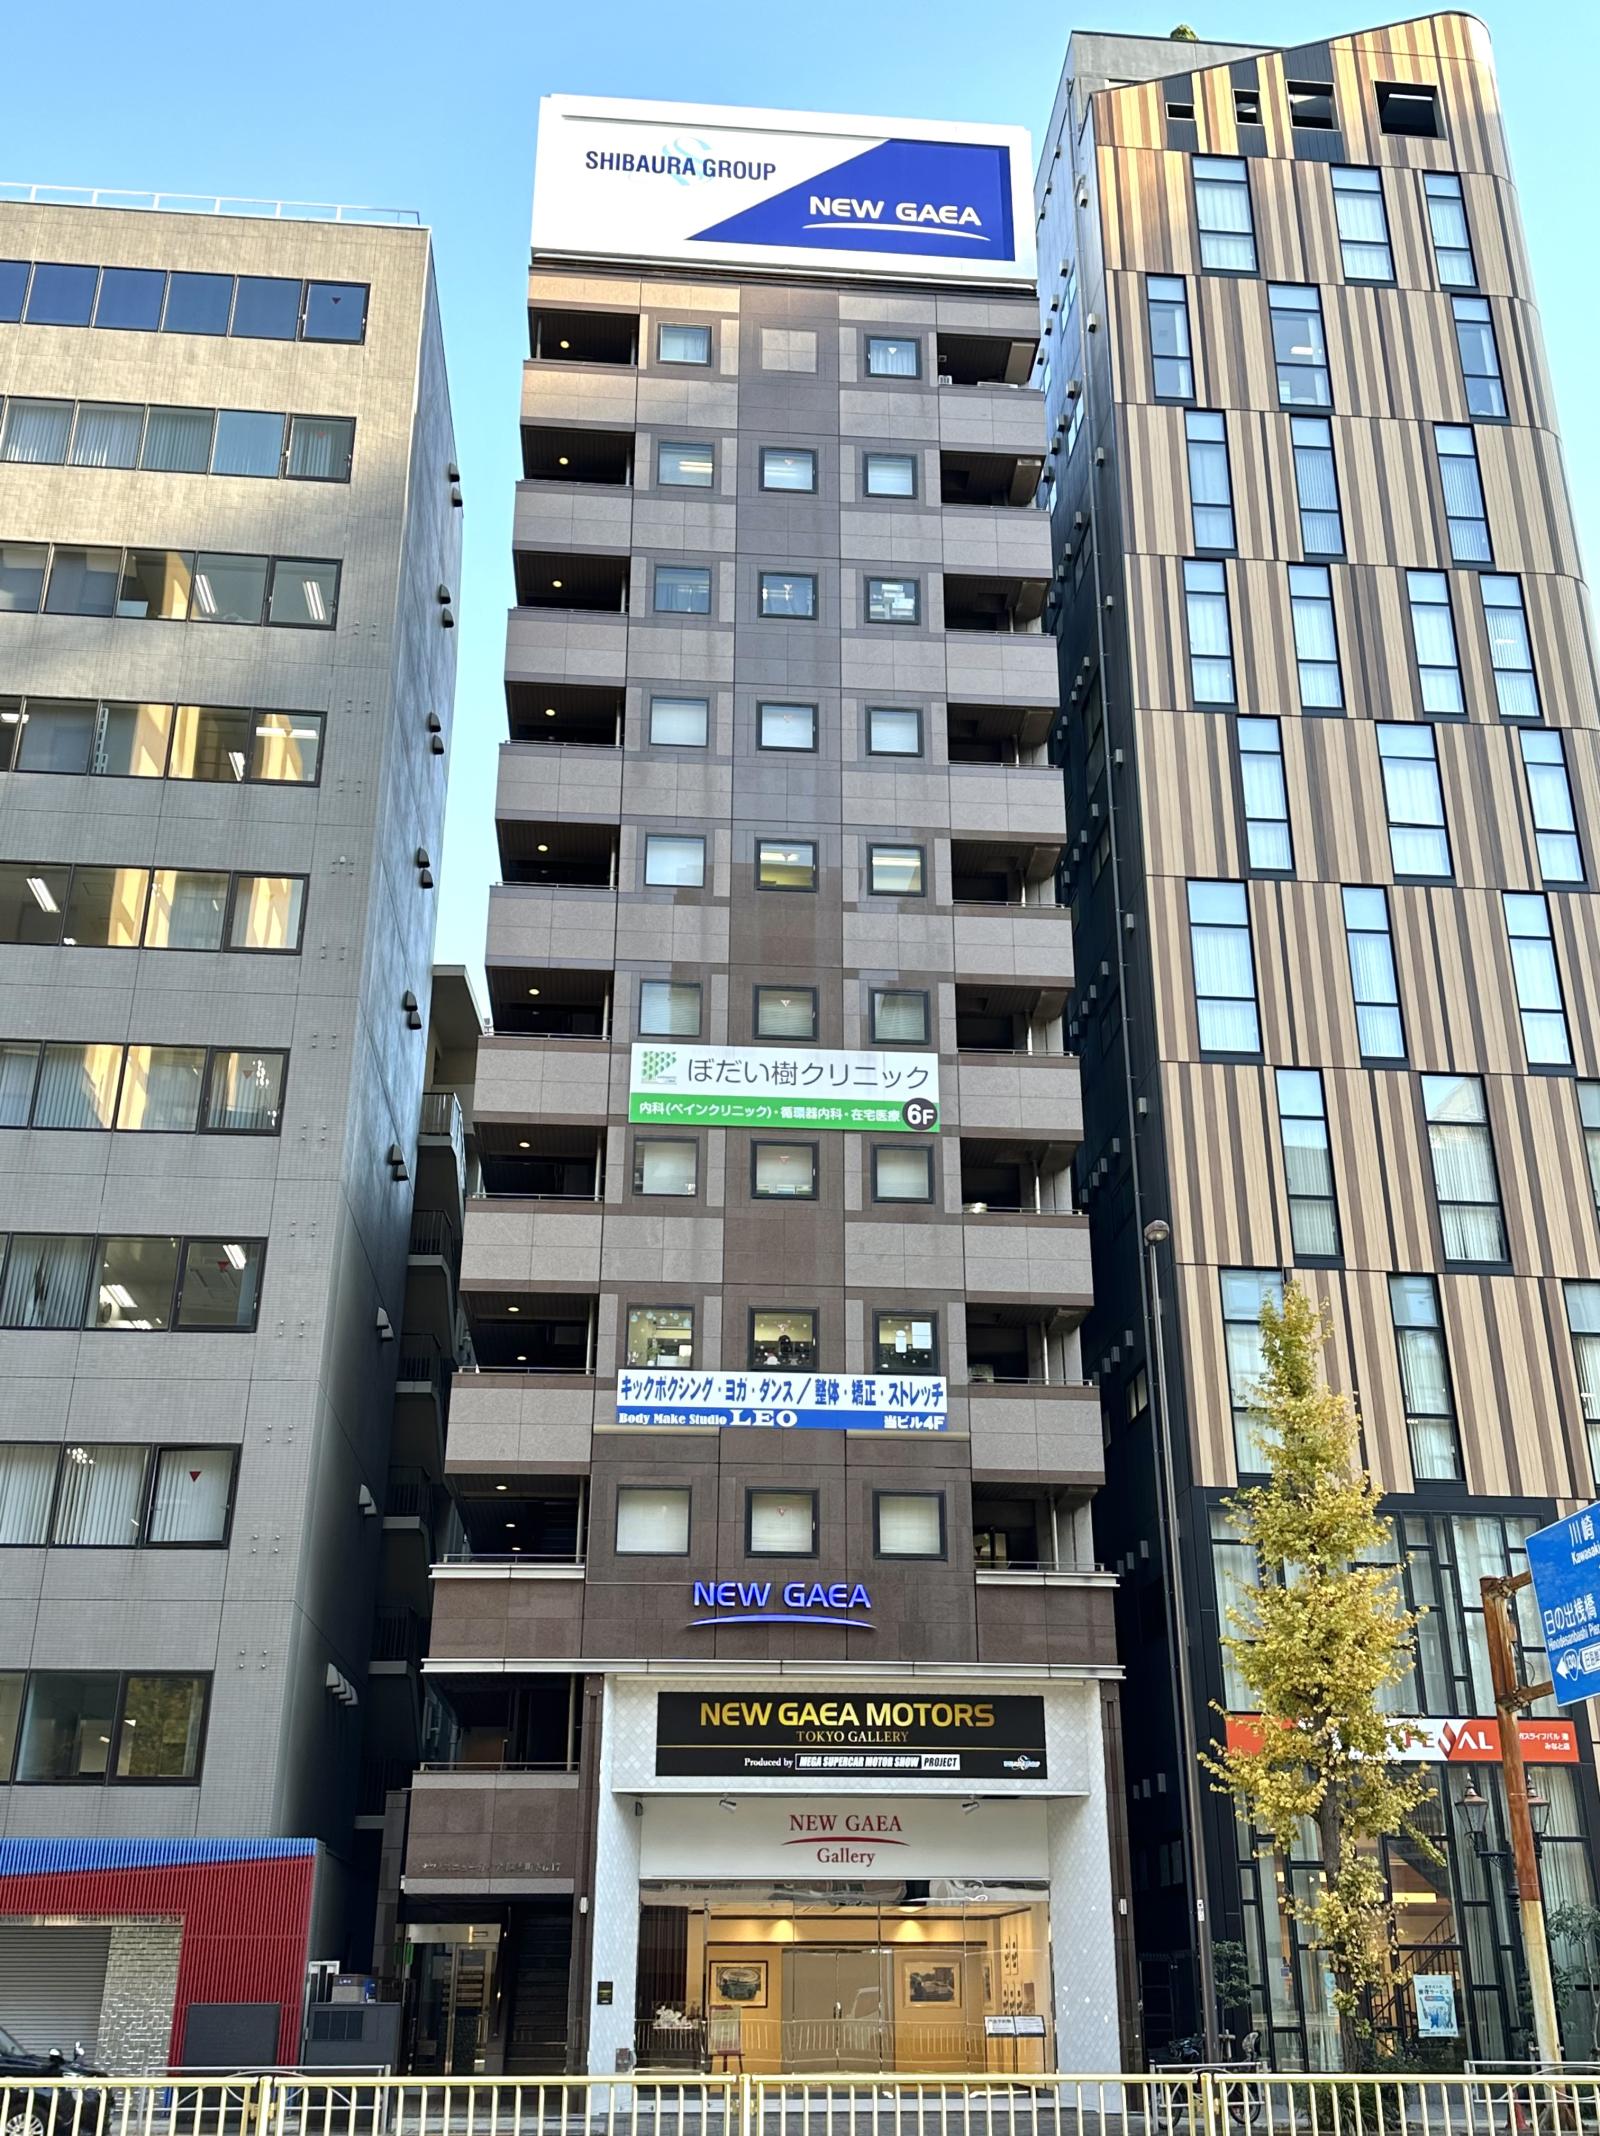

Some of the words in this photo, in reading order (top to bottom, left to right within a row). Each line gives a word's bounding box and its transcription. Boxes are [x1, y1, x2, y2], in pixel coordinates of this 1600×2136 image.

[585, 150, 696, 176] SHIBAURA
[702, 158, 776, 181] GROUP
[809, 195, 885, 219] NEW
[895, 202, 982, 226] GAEA
[687, 1058, 929, 1090] ぼだい樹クリニック
[906, 1103, 935, 1126] 6F
[618, 1412, 651, 1425] Body
[653, 1412, 687, 1425] Make
[689, 1413, 728, 1426] Studio
[729, 1409, 798, 1428] LEO
[883, 1414, 945, 1431] 当ビル4F
[1568, 1514, 1595, 1549] 川崎
[1570, 1540, 1600, 1566] Kawasaki
[692, 1580, 771, 1608] NEW
[782, 1581, 872, 1609] GAEA
[1543, 1592, 1598, 1636] 日の出桟橋
[700, 1702, 773, 1727] NEW
[777, 1702, 860, 1727] GAEA
[865, 1702, 996, 1728] MOTORS
[795, 1729, 845, 1743] TOKYO
[847, 1730, 909, 1744] GALLERY
[744, 1756, 782, 1767] Produced
[783, 1757, 794, 1769] by
[799, 1756, 822, 1768] MEGA
[823, 1756, 864, 1768] SUPERCAR
[864, 1756, 894, 1768] MOTOR
[894, 1756, 920, 1768] SHOW
[923, 1756, 958, 1769] PROJECT
[789, 1814, 839, 1832] NEW
[845, 1814, 903, 1833] GAEA
[816, 1847, 876, 1868] Gallery
